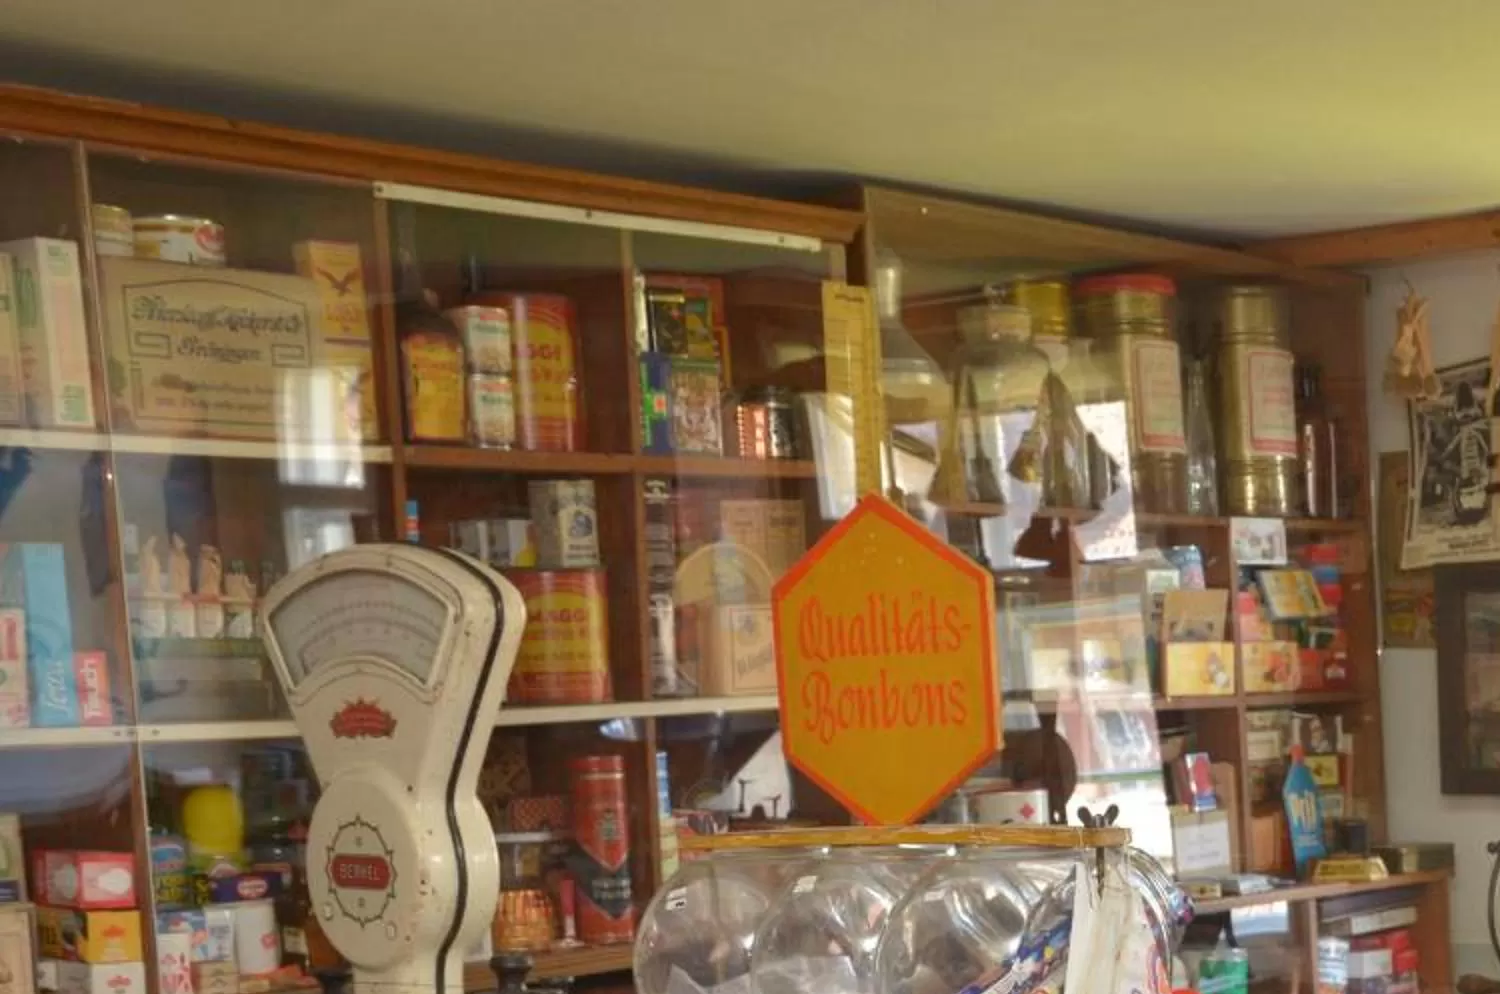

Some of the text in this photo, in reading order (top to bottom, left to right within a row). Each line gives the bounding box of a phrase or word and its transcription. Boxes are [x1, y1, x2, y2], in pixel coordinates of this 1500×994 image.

[799, 586, 972, 663] Qualitäts-
[800, 669, 967, 745] Bonbons
[339, 863, 380, 881] BERKEL
